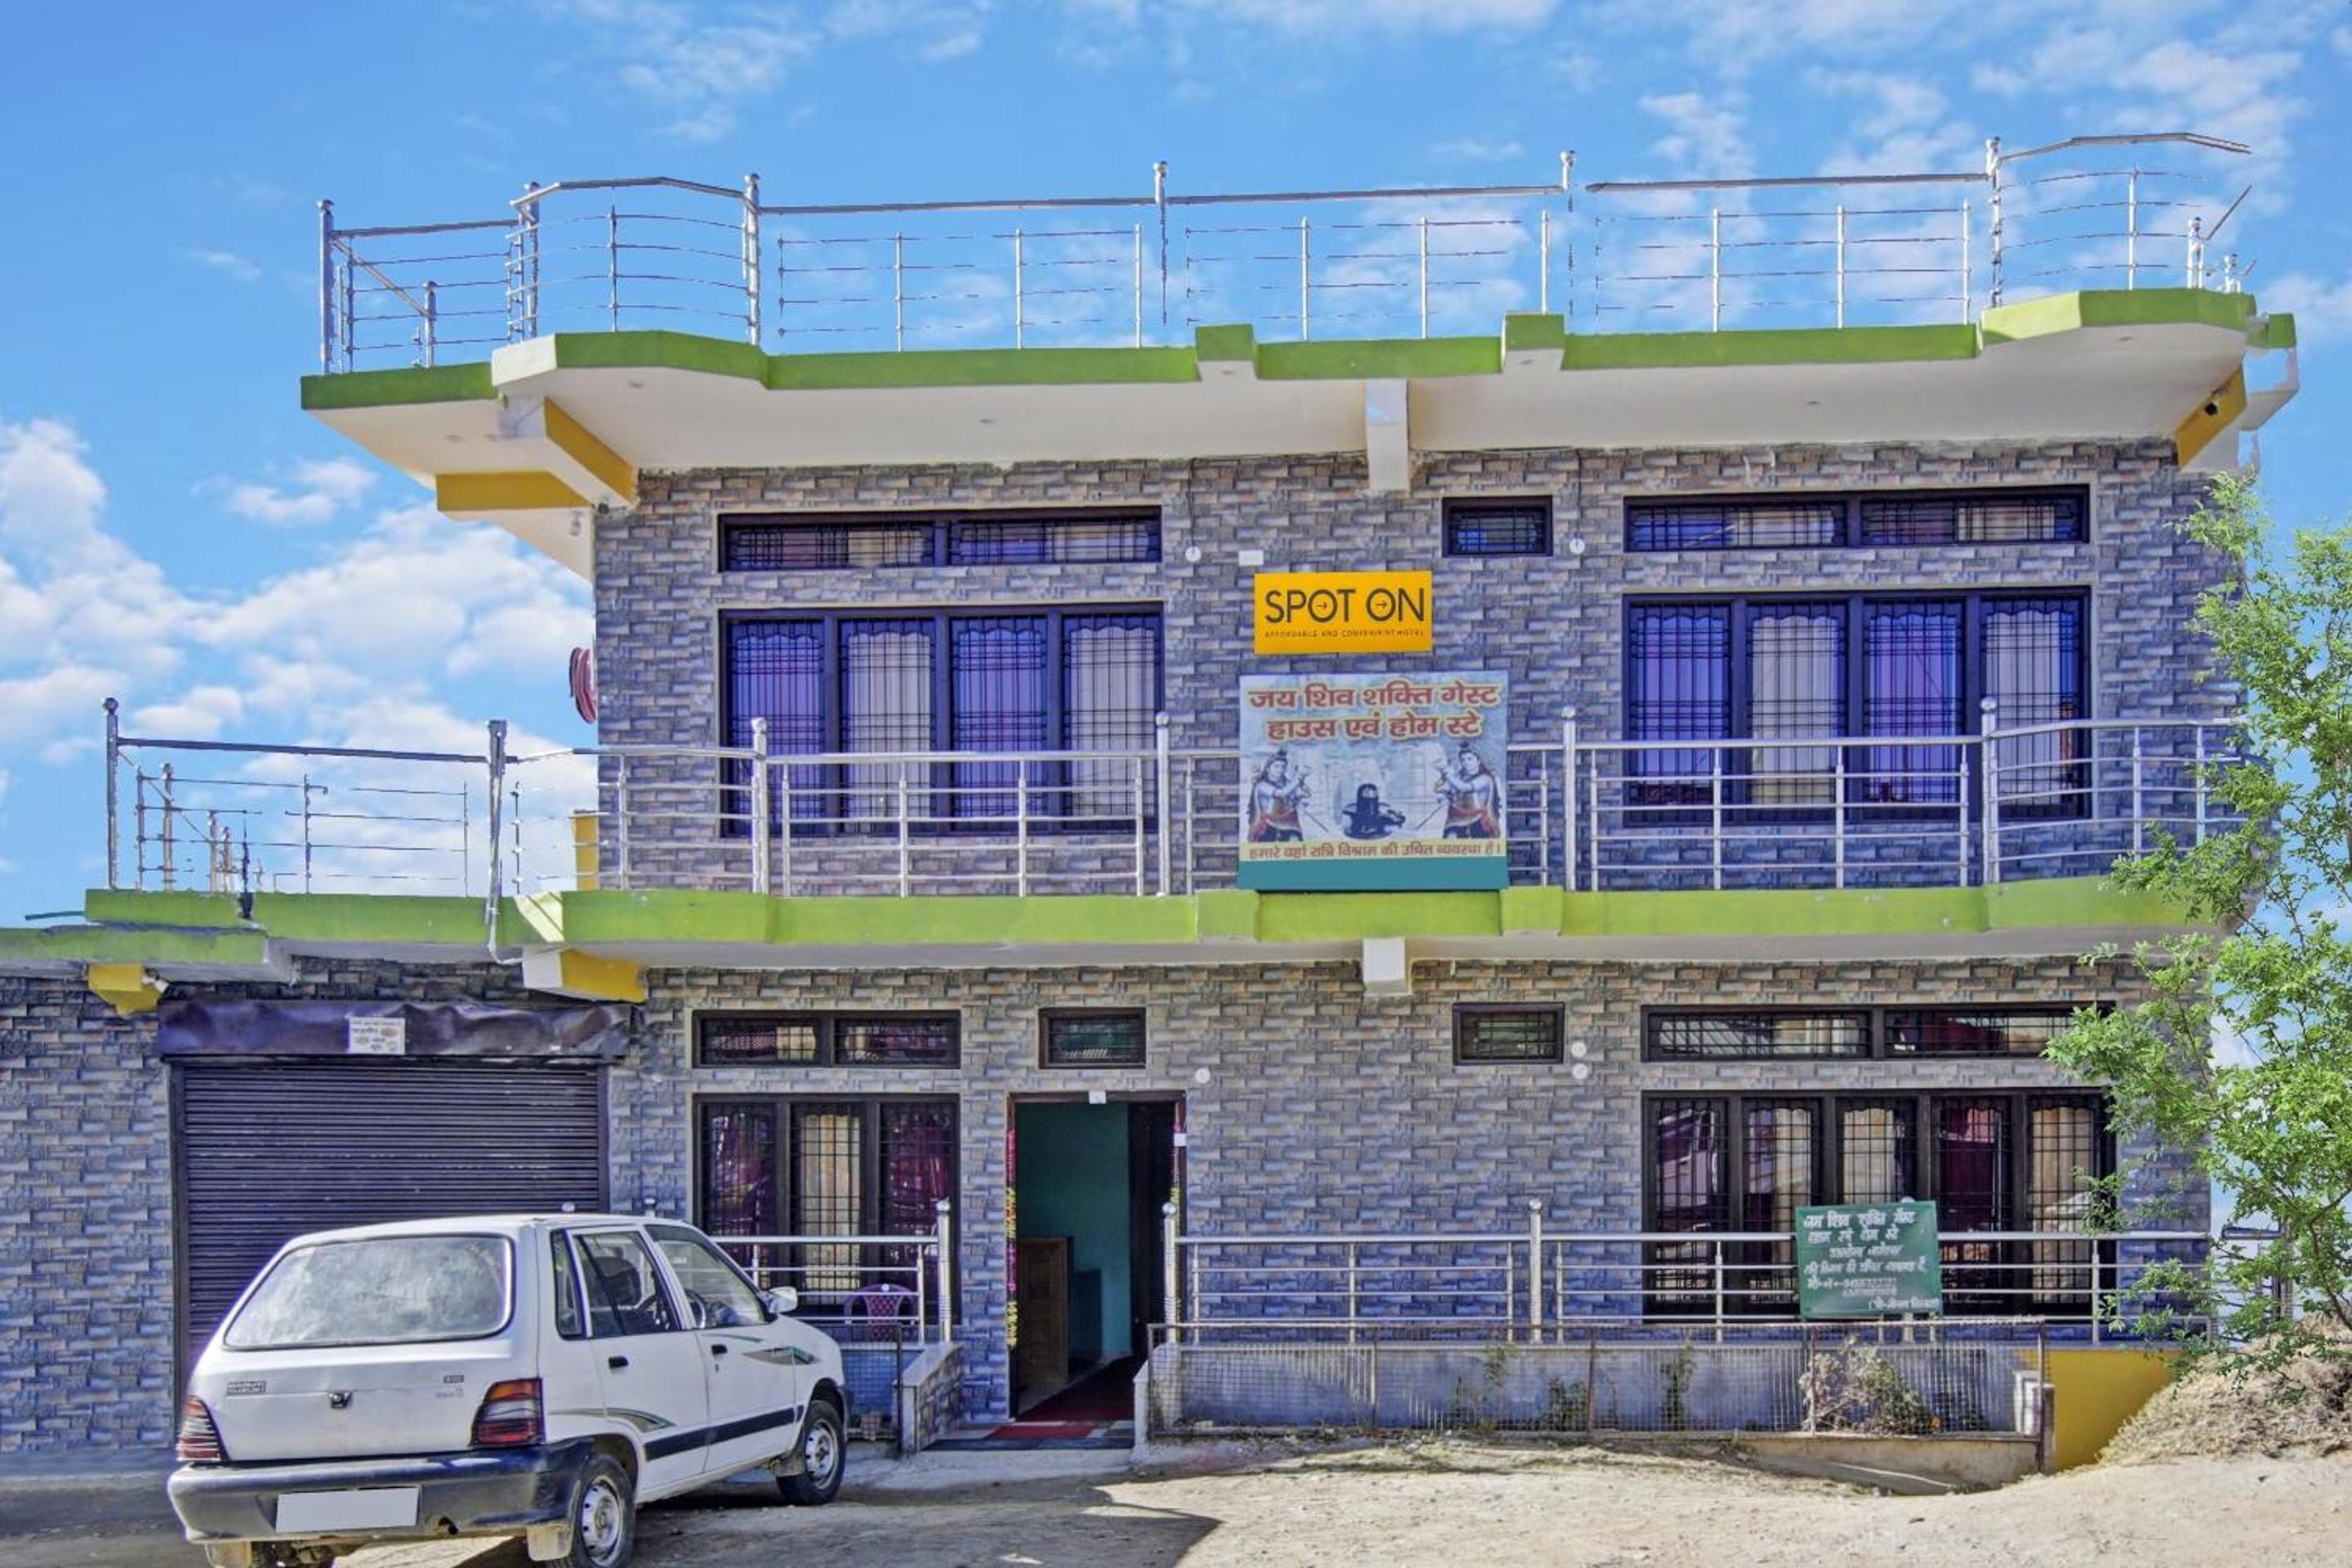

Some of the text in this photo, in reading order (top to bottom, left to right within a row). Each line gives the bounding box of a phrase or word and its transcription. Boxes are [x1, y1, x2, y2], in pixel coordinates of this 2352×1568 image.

[1265, 587, 1424, 623] SPOT ON
[1248, 679, 1499, 708] जय शिव शक्ति गेस्ट
[1267, 710, 1481, 739] हाउस एवं होम स्टे
[1250, 844, 1281, 858] हमारे
[1310, 842, 1334, 857] रात्रि
[1339, 842, 1378, 857] विश्राम
[1381, 841, 1398, 856] की
[1401, 841, 1433, 855] उचित
[1437, 843, 1481, 855] व्यवस्था
